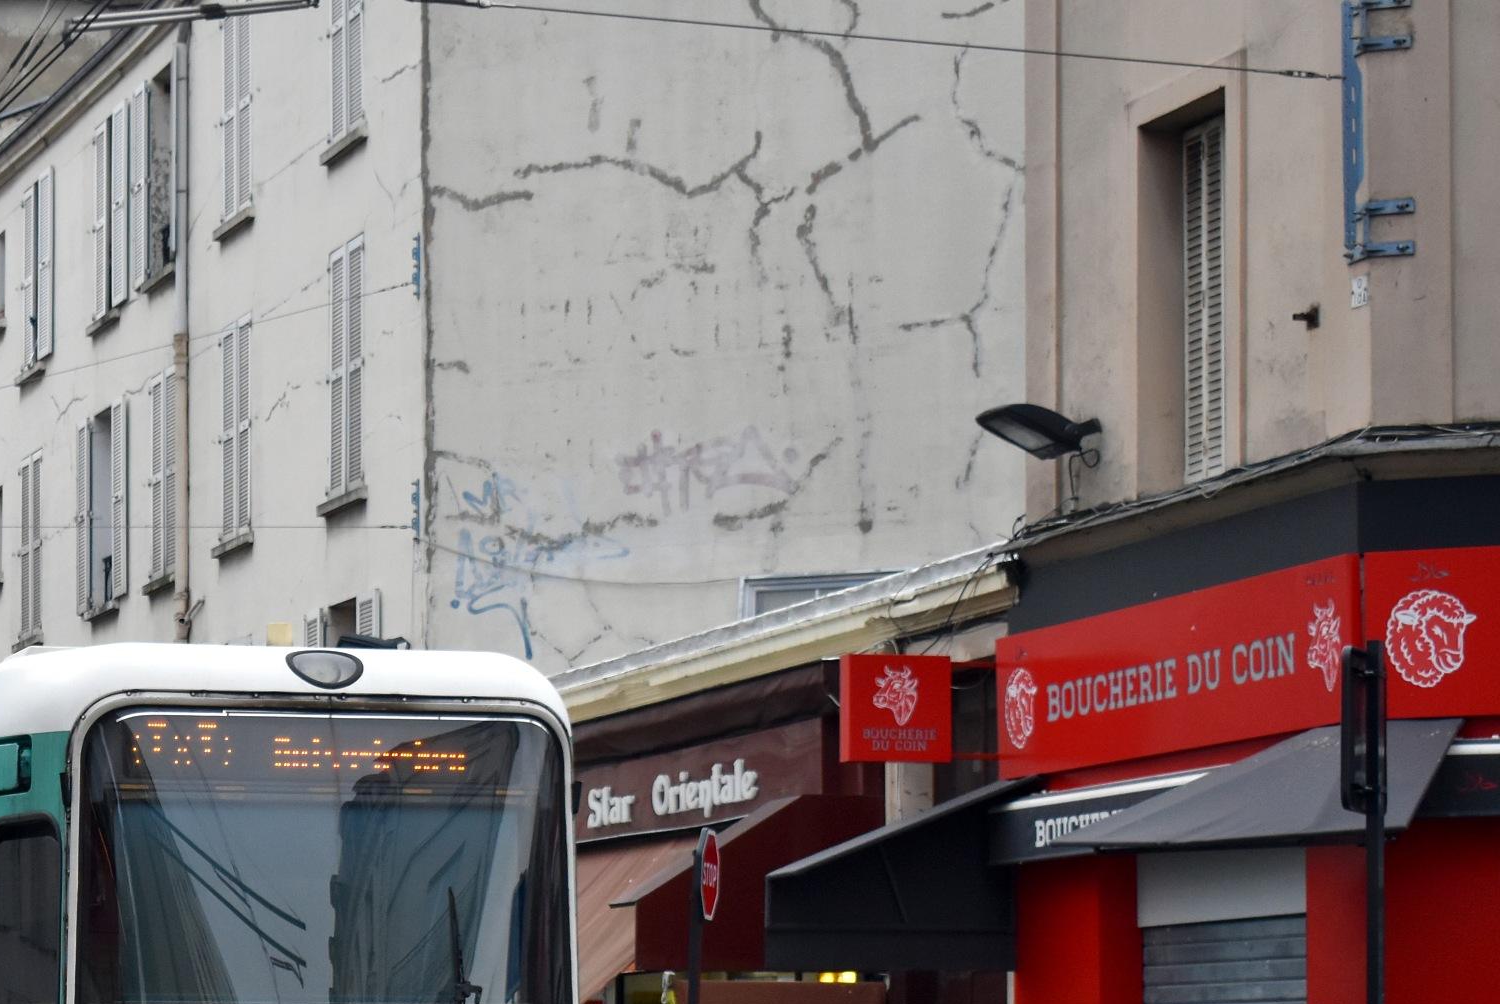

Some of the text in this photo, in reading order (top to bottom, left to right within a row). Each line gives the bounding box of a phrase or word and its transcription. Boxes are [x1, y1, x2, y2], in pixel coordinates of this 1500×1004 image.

[1047, 633, 1296, 722] BOUCHERIE DU COIN
[862, 728, 938, 740] BOUCHERIE
[872, 740, 928, 752] DU COIN
[587, 758, 759, 828] Star Orientale
[703, 862, 717, 888] STOP
